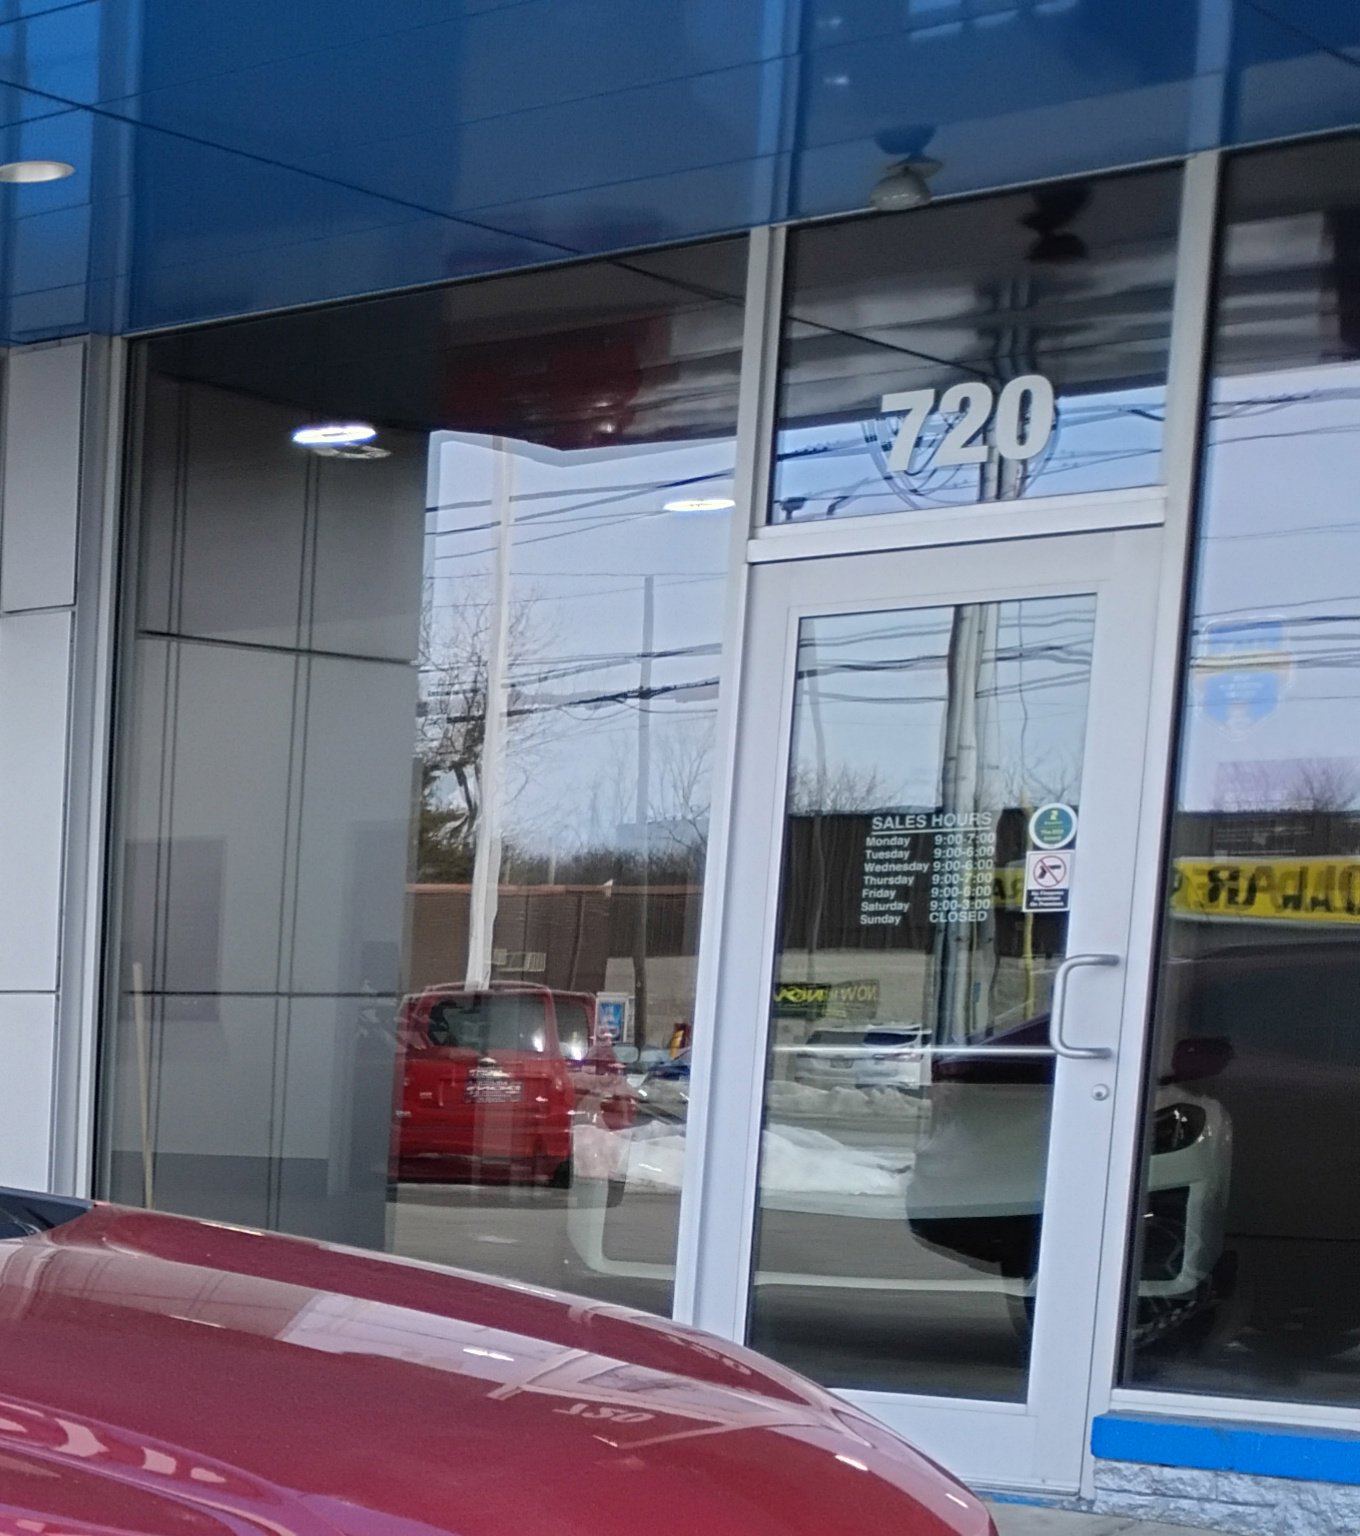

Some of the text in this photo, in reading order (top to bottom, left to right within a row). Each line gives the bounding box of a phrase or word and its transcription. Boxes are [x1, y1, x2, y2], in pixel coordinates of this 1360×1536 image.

[881, 374, 1055, 472] 720
[871, 811, 993, 830] SALES HOURS
[865, 836, 911, 847] Monday
[865, 849, 911, 860] Tuesday
[863, 862, 930, 873] Wednesday
[863, 875, 915, 886] Thursday
[862, 888, 897, 900] Friday
[860, 901, 910, 913] Saturday
[860, 911, 988, 925] Sunday CLOSED
